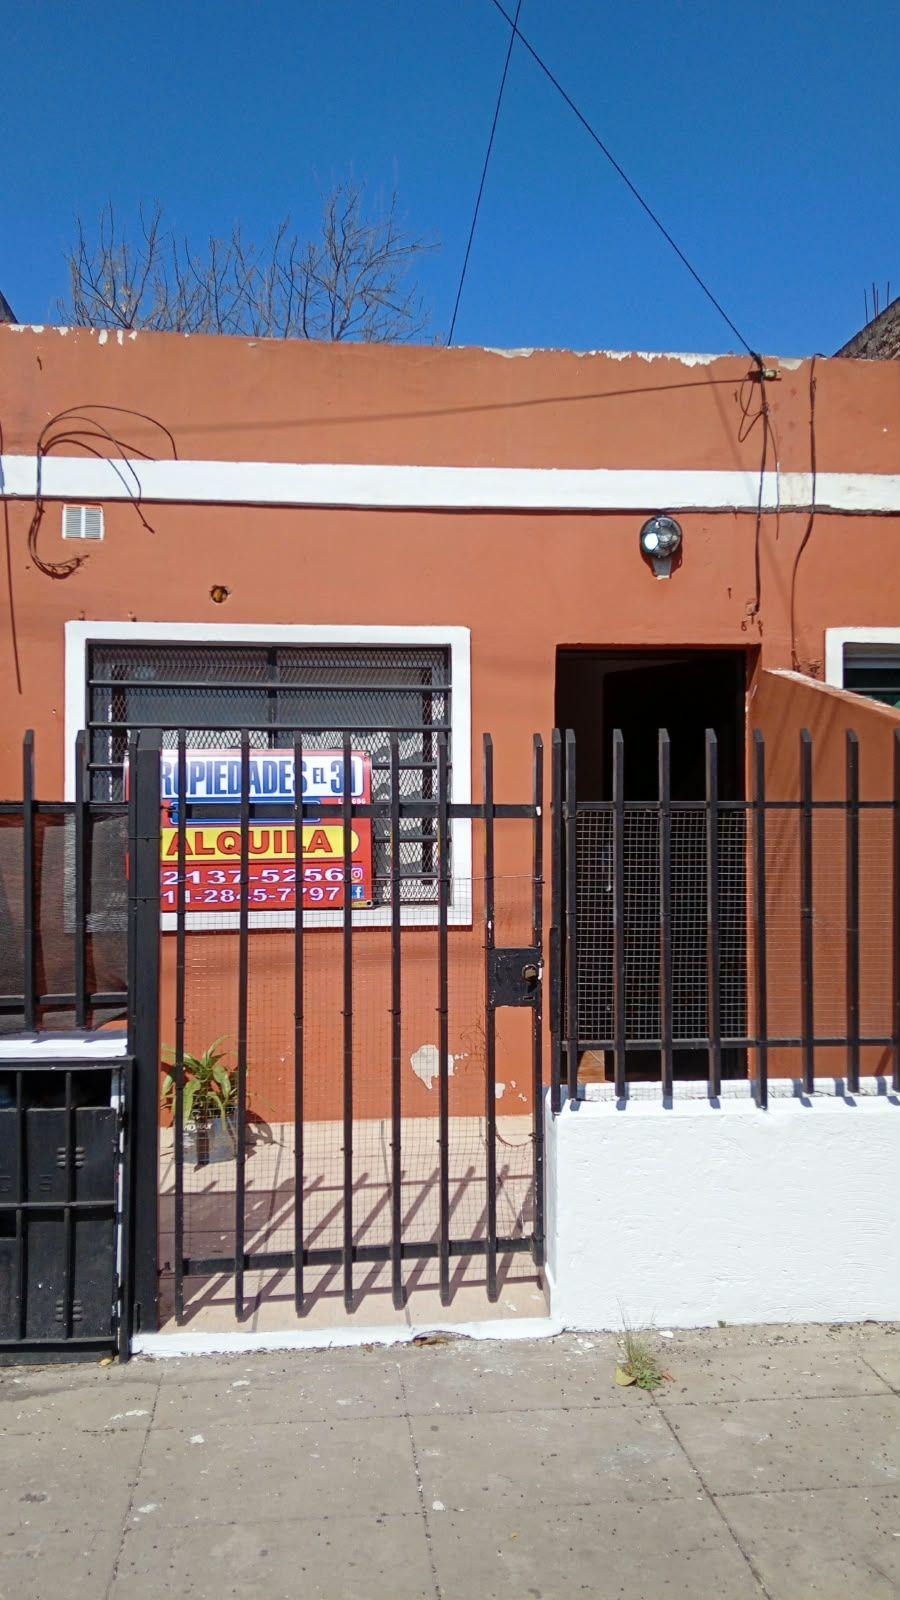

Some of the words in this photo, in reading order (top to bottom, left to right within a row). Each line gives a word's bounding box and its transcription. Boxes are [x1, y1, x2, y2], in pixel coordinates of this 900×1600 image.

[161, 760, 308, 795] ROPIEDADES
[312, 767, 327, 784] EL
[165, 829, 334, 856] ALQUILA
[162, 886, 341, 904] 11-285-797
